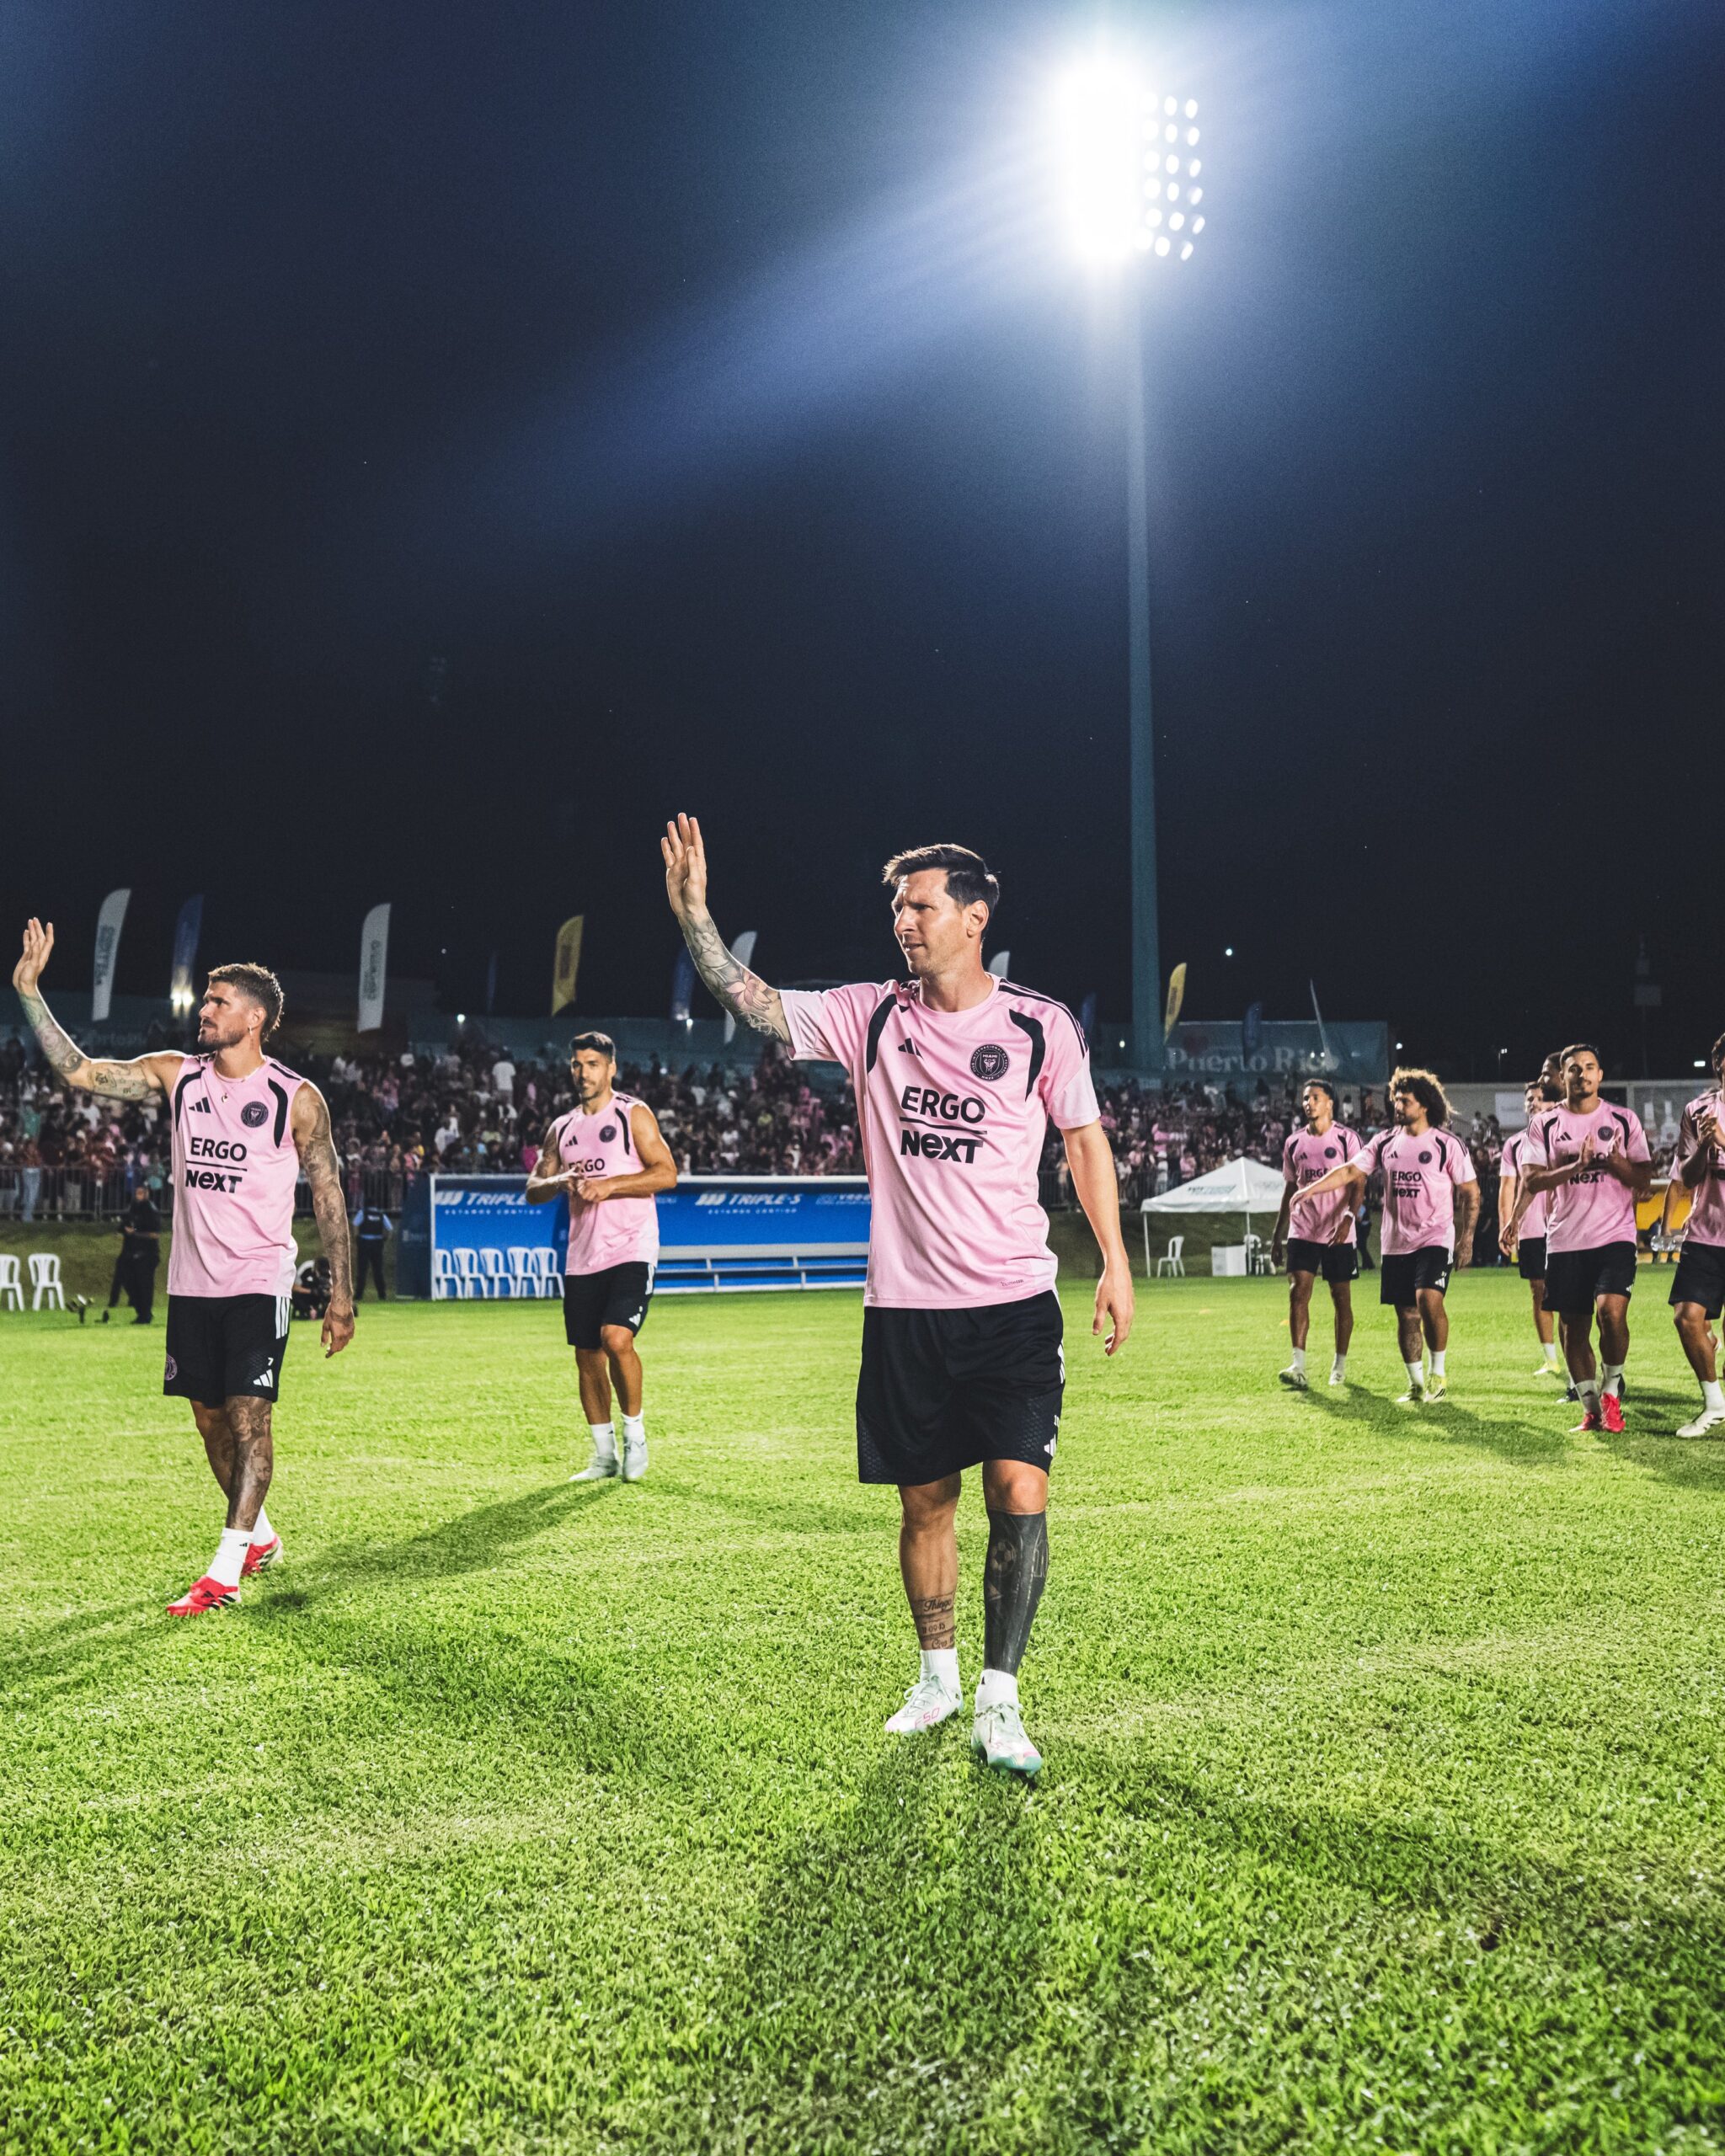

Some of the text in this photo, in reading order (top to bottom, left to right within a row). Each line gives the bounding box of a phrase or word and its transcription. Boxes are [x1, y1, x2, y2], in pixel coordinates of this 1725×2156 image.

[1167, 1046, 1268, 1073] Puerto
[901, 1086, 985, 1123] ERGO
[190, 1137, 248, 1162] ERGO
[1391, 1171, 1422, 1182] ERGO
[267, 1357, 274, 1366] 7
[915, 1707, 940, 1729] F50
